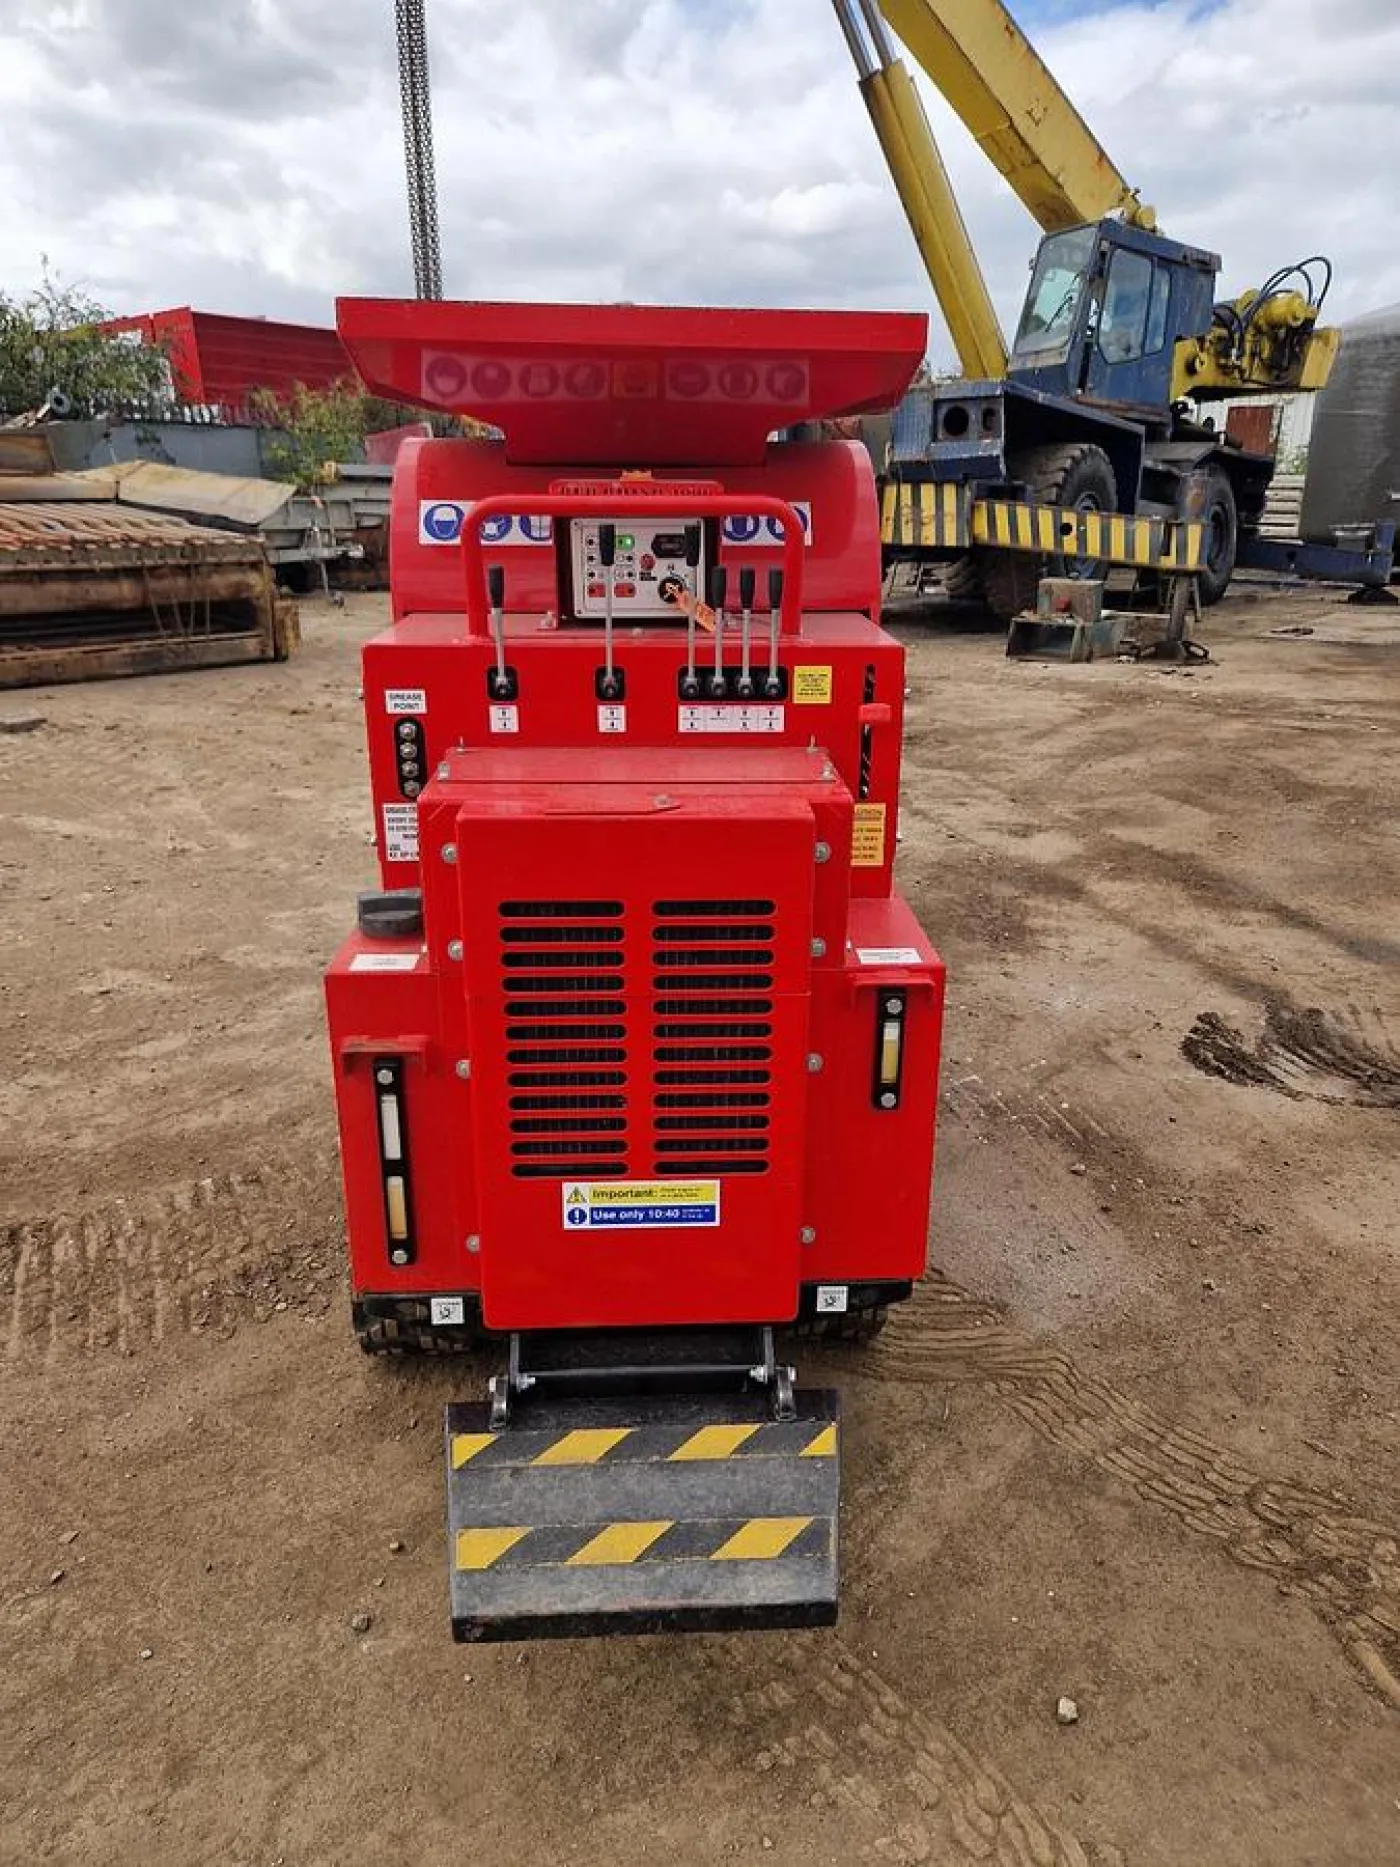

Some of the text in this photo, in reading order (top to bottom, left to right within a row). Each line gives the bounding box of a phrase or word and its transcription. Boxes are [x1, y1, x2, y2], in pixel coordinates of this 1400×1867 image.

[389, 692, 422, 701] GREASE
[394, 702, 420, 711] POINT
[592, 1188, 658, 1200] Important:
[592, 1209, 617, 1220] Use
[619, 1209, 645, 1222] only
[648, 1208, 680, 1219] 10:40
